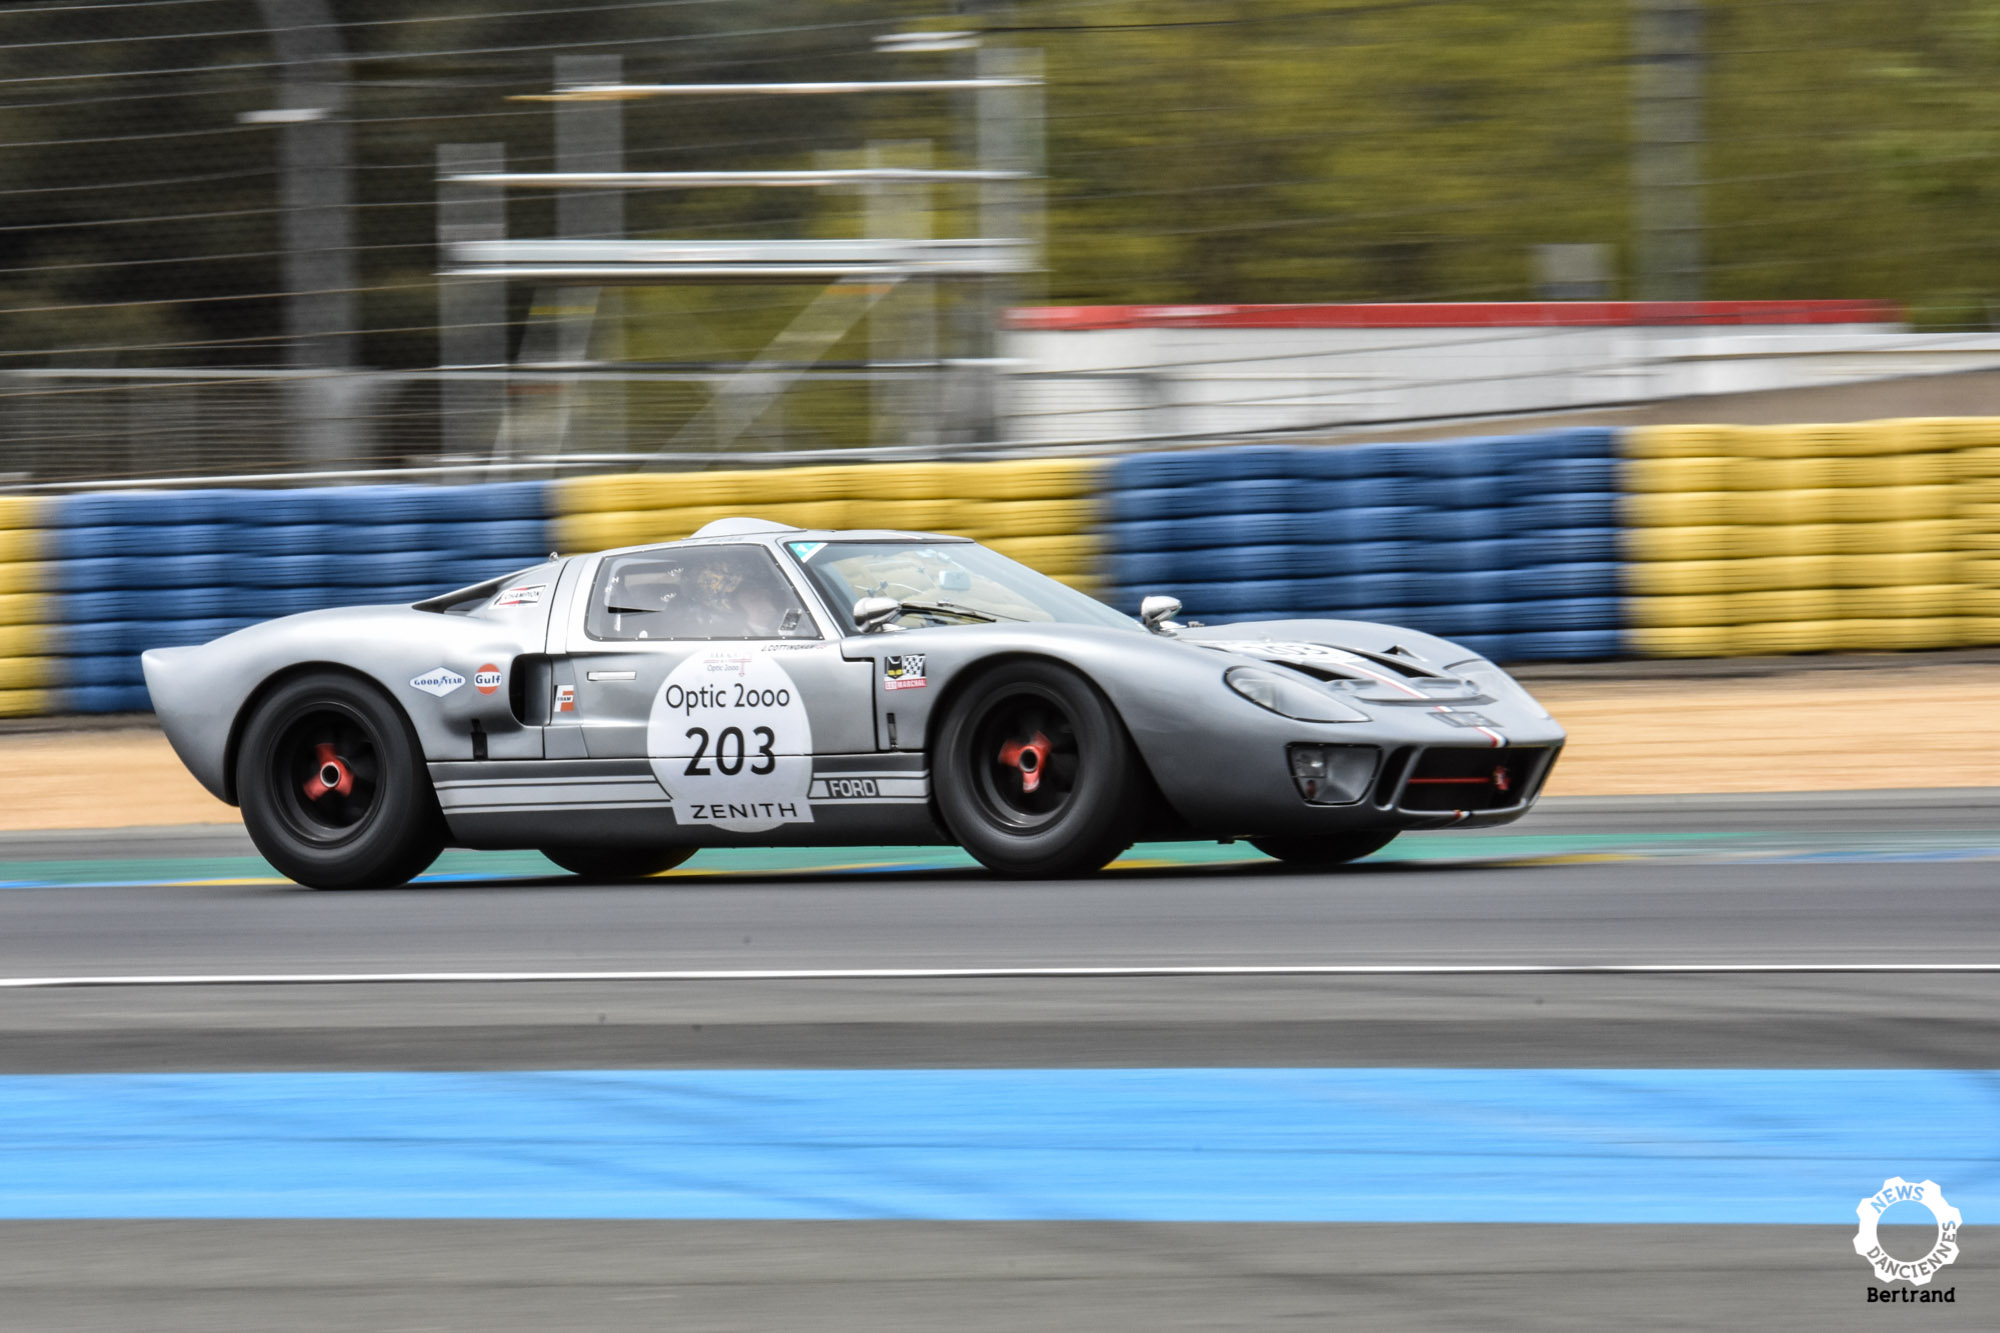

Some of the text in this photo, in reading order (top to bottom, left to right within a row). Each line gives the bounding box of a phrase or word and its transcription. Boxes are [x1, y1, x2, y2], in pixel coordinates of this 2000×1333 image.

[475, 674, 502, 685] Gulf
[666, 683, 727, 716] Optic
[683, 726, 776, 776] 203
[831, 779, 876, 797] FORD
[690, 802, 798, 819] ZENITH
